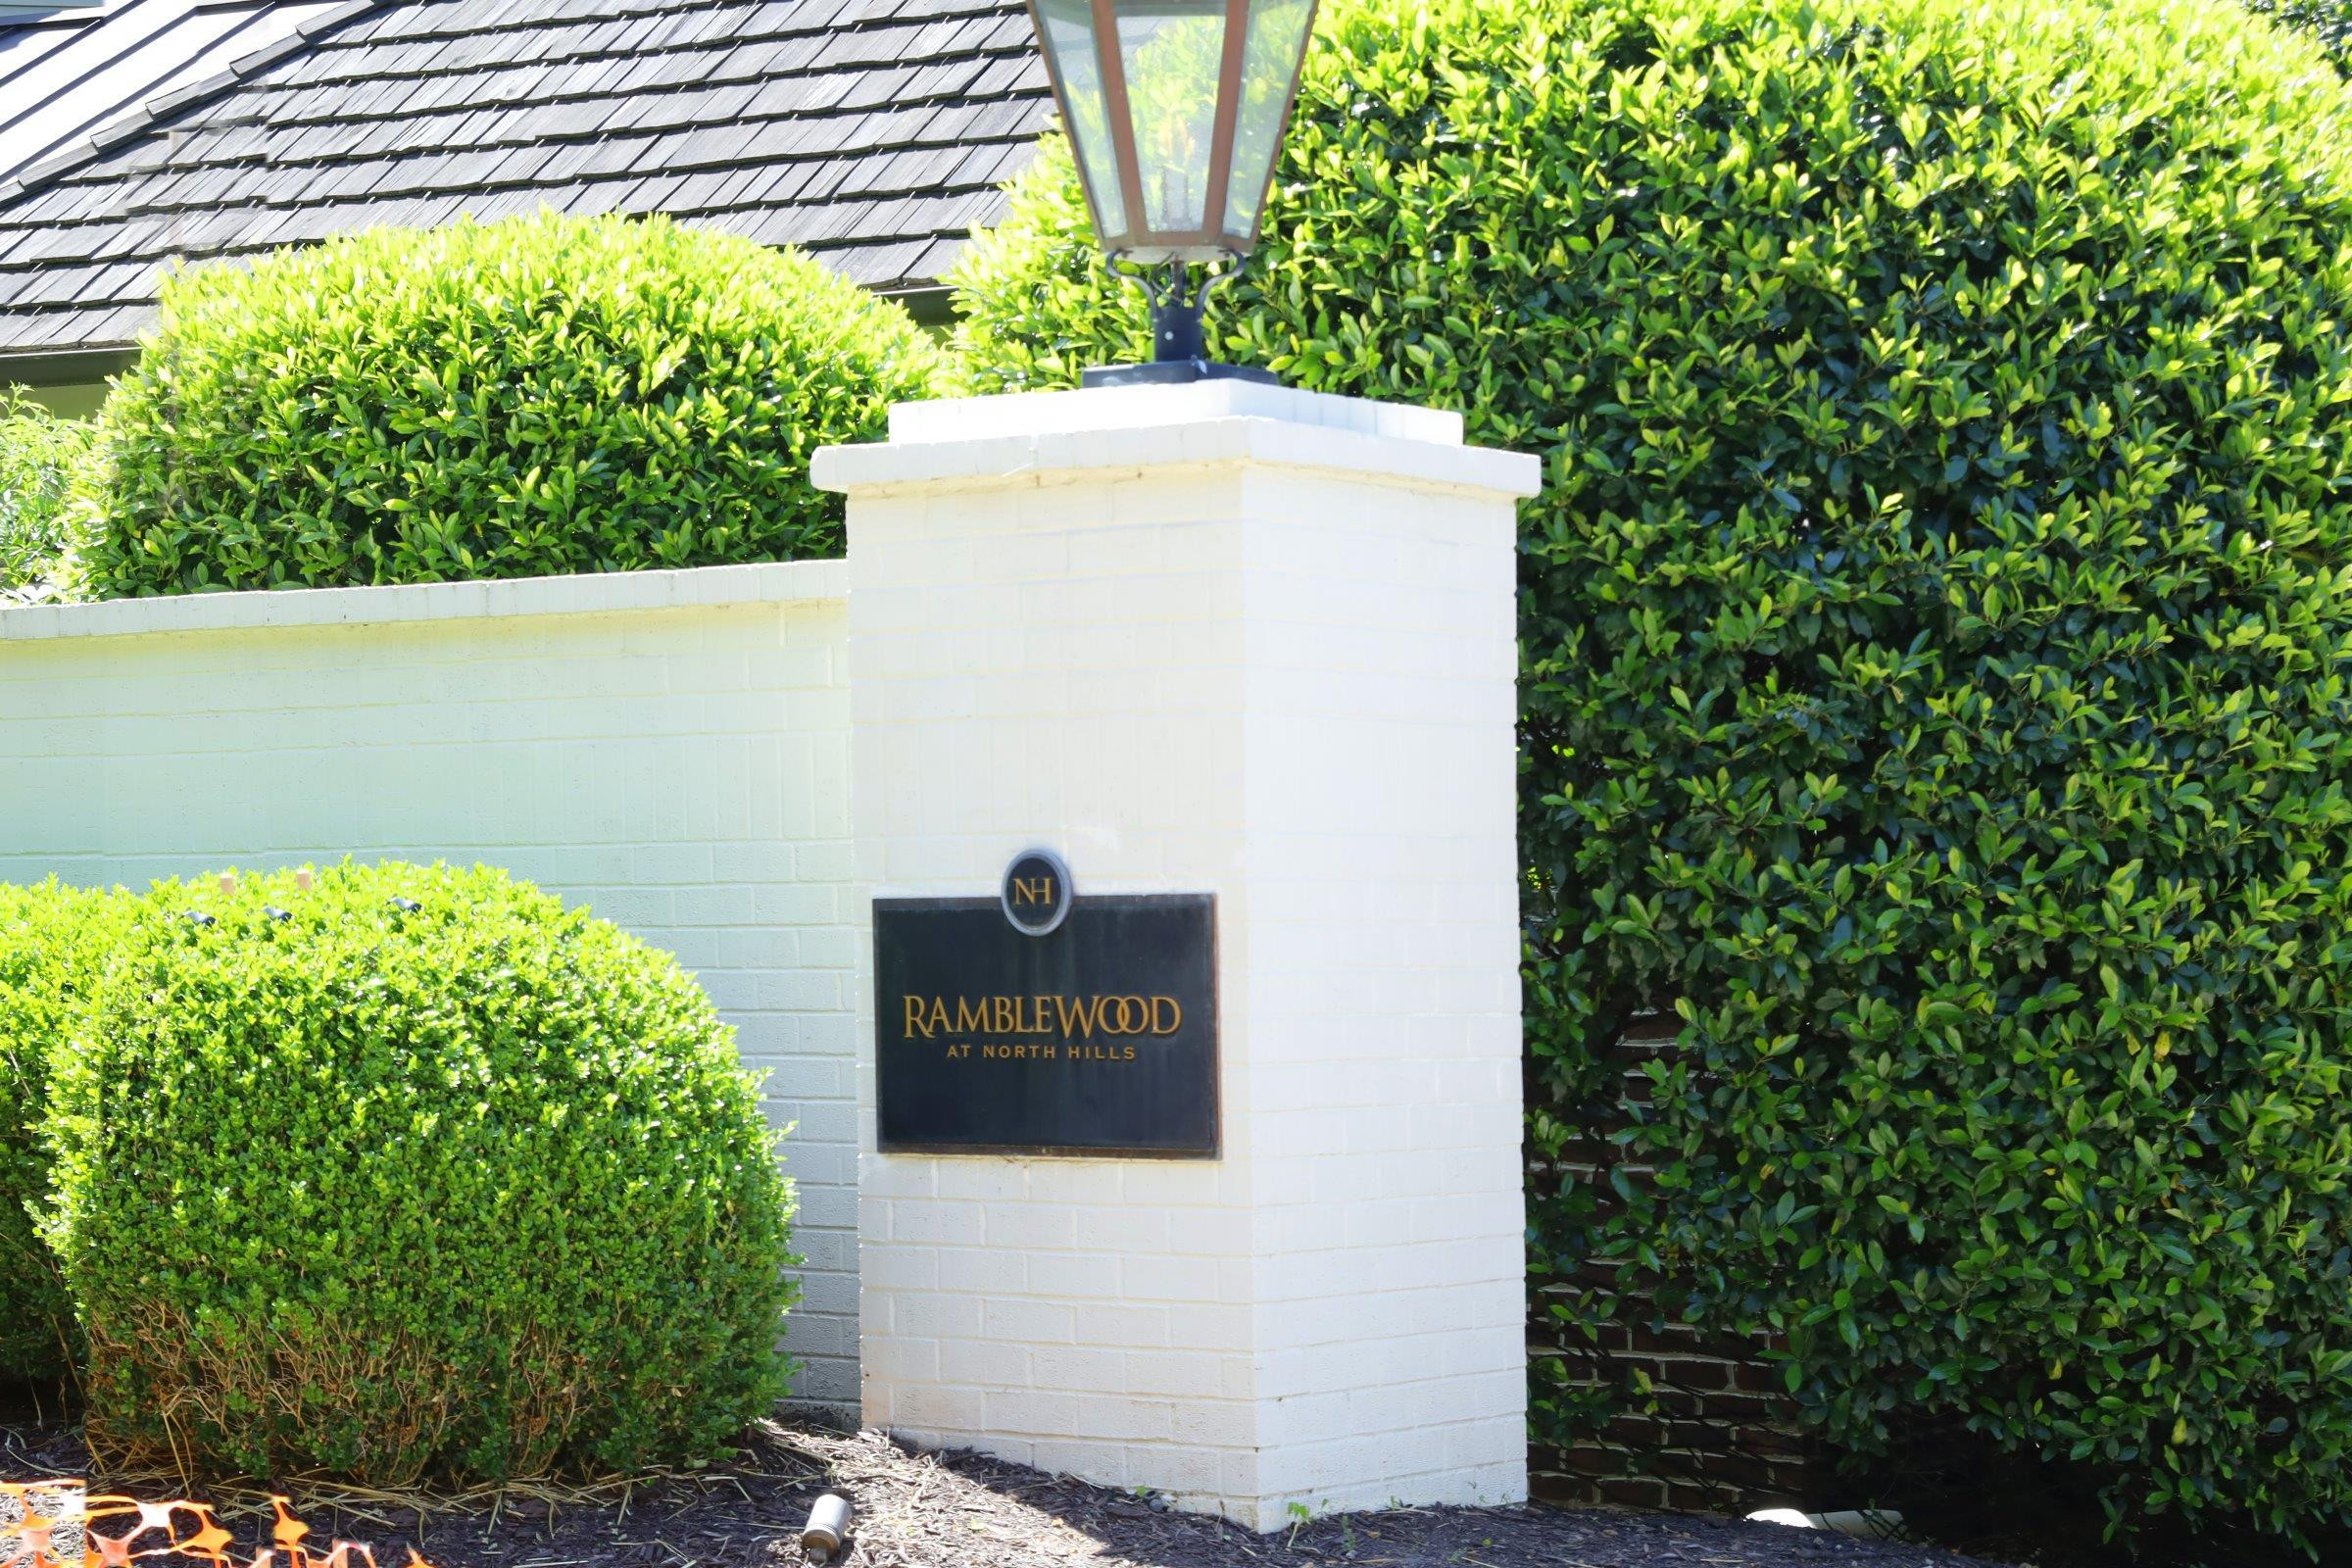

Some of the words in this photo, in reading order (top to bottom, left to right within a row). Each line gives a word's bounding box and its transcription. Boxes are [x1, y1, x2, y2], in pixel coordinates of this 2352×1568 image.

[1013, 877, 1054, 905] NH
[903, 995, 1183, 1039] RAMBLEWOOD
[947, 1045, 970, 1057] AT
[983, 1046, 1056, 1058] NORTH
[1068, 1047, 1136, 1060] HILLS
